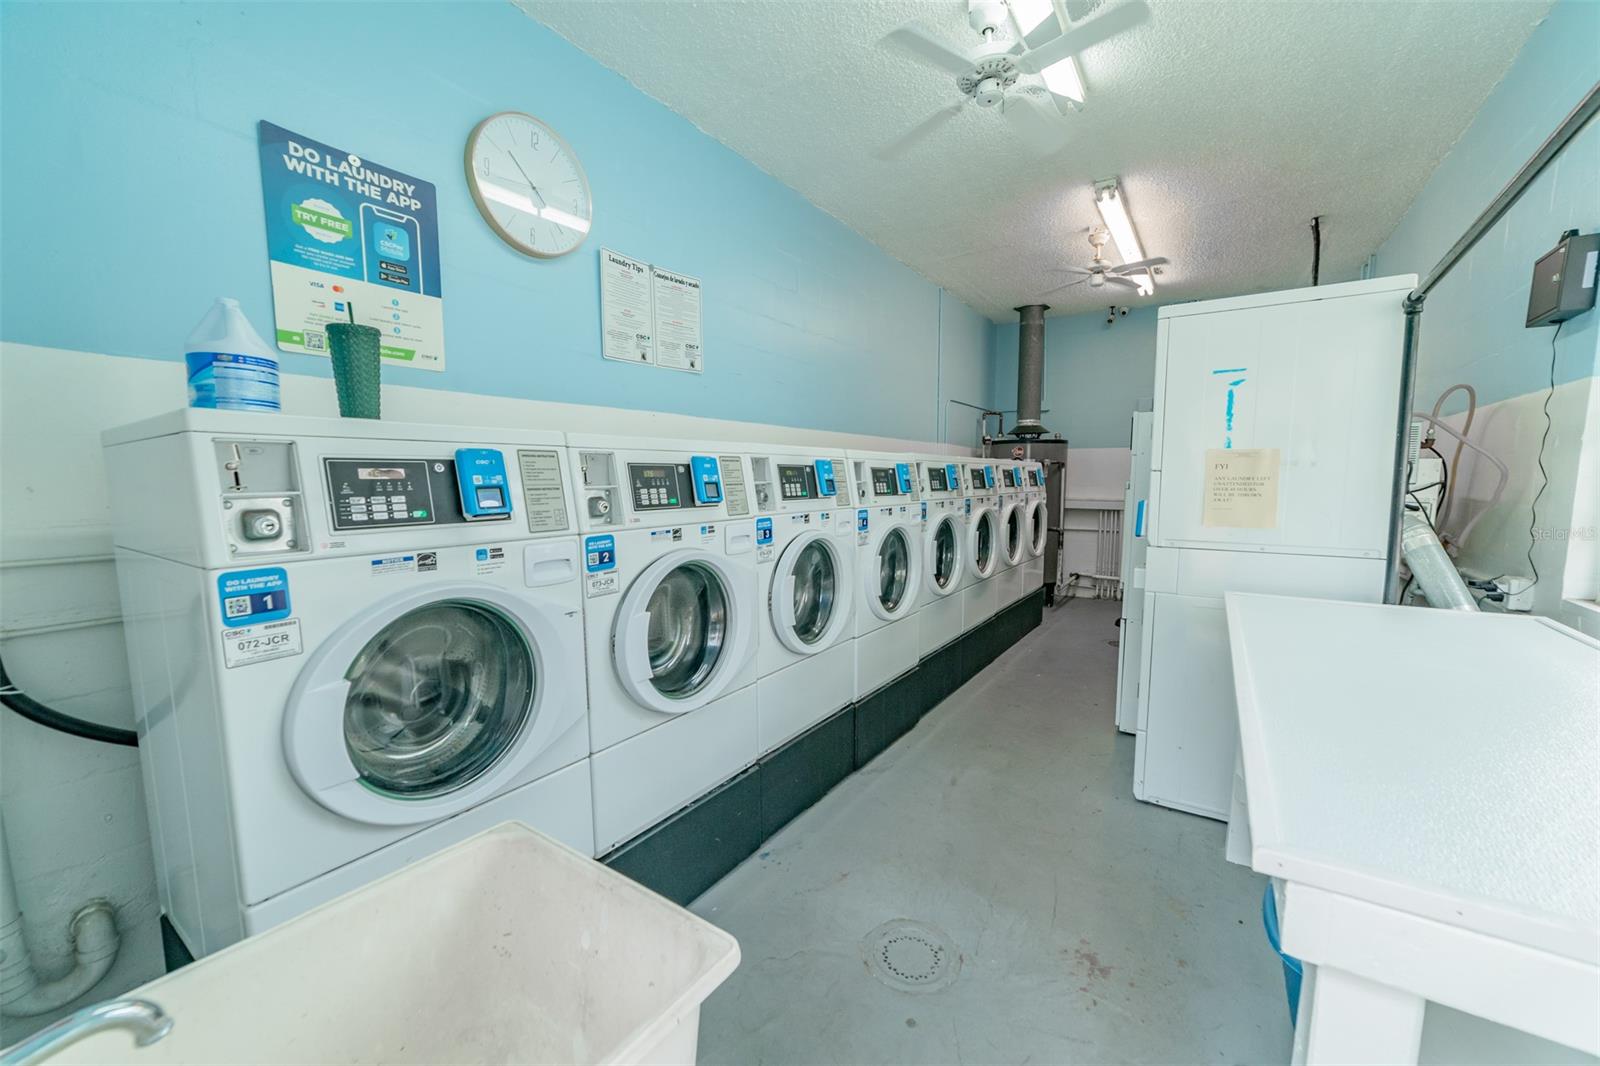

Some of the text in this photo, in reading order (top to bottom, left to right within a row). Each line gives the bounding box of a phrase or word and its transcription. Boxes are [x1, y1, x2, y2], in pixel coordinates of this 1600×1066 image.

[530, 130, 539, 151] 12
[288, 141, 416, 197] DO LAUNDRY
[484, 157, 490, 176] 9
[283, 154, 422, 211] WITH THE APP
[295, 210, 349, 232] TRY FREE
[530, 227, 536, 245] 6
[608, 254, 644, 273] Laundry Tips
[309, 281, 325, 289] VISA
[765, 530, 770, 538] 3
[602, 552, 609, 562] 2
[241, 575, 279, 585] LAUNDRY
[249, 582, 265, 590] THE
[262, 594, 274, 610] 1
[225, 630, 245, 638] CSC
[237, 634, 290, 651] 072-JCR
